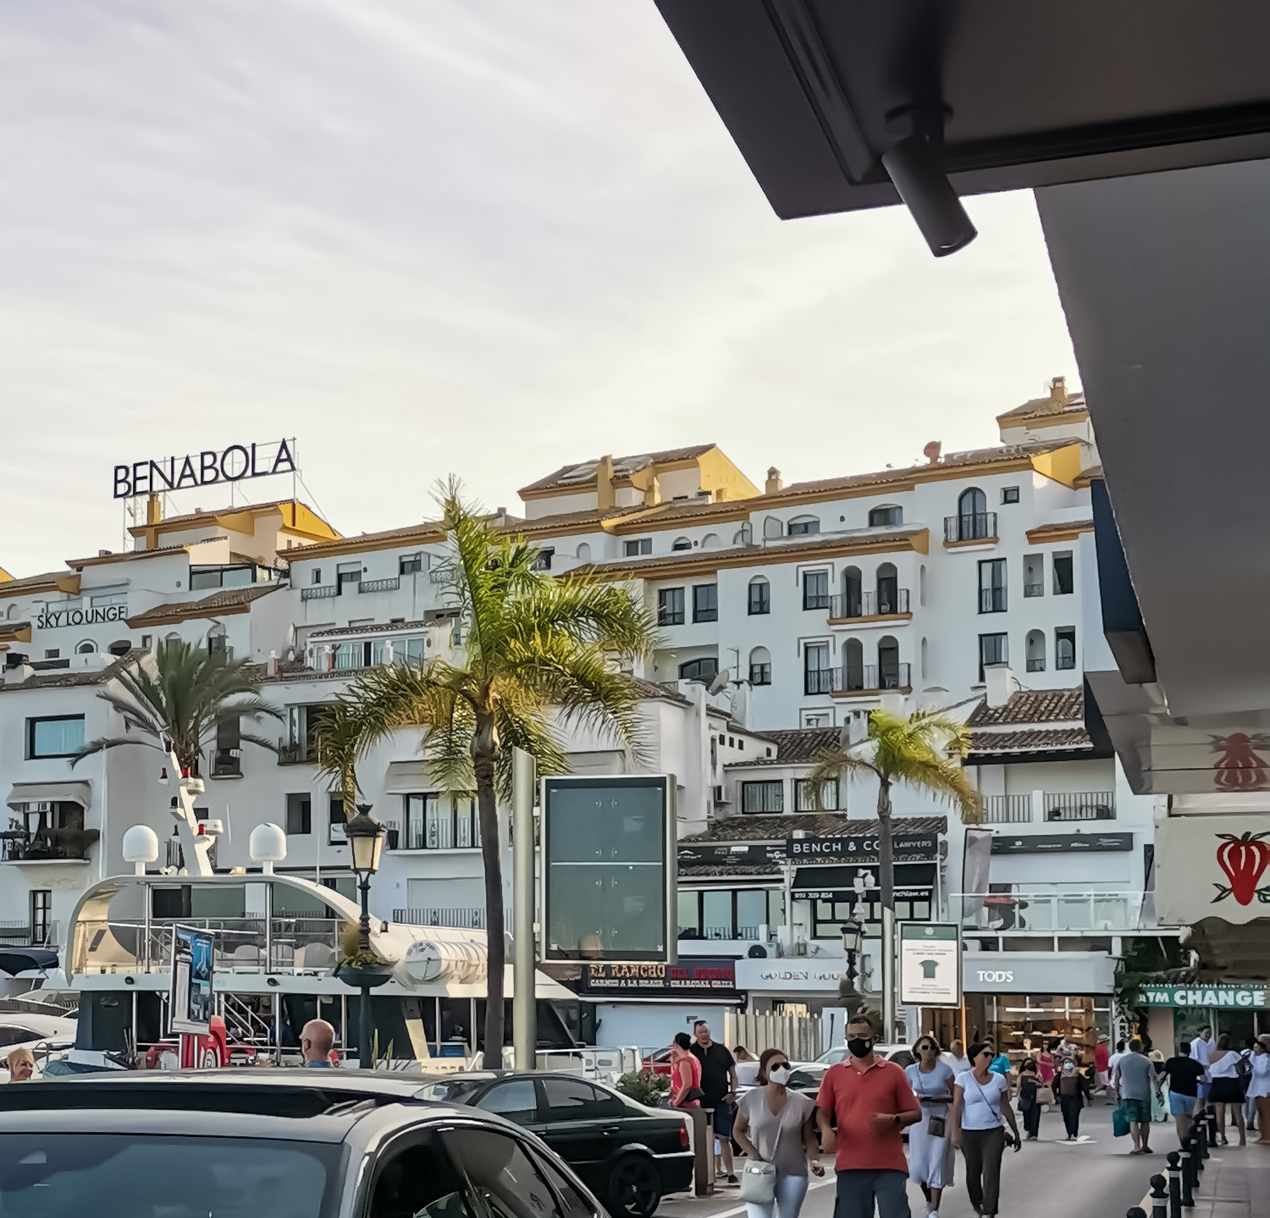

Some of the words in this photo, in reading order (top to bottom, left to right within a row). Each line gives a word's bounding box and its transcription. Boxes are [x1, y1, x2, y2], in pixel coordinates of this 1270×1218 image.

[113, 438, 297, 499] BENABOLA
[37, 612, 62, 629] SKY
[66, 606, 126, 626] LOUNGE
[792, 842, 842, 854] BENCH
[847, 841, 857, 851] &
[894, 840, 932, 848] LAWYERS
[590, 964, 606, 977] EL
[610, 964, 666, 978] RANCHO
[760, 971, 809, 981] GOLDEN
[977, 970, 1014, 983] TOD'S
[1174, 990, 1266, 1006] CHANGE
